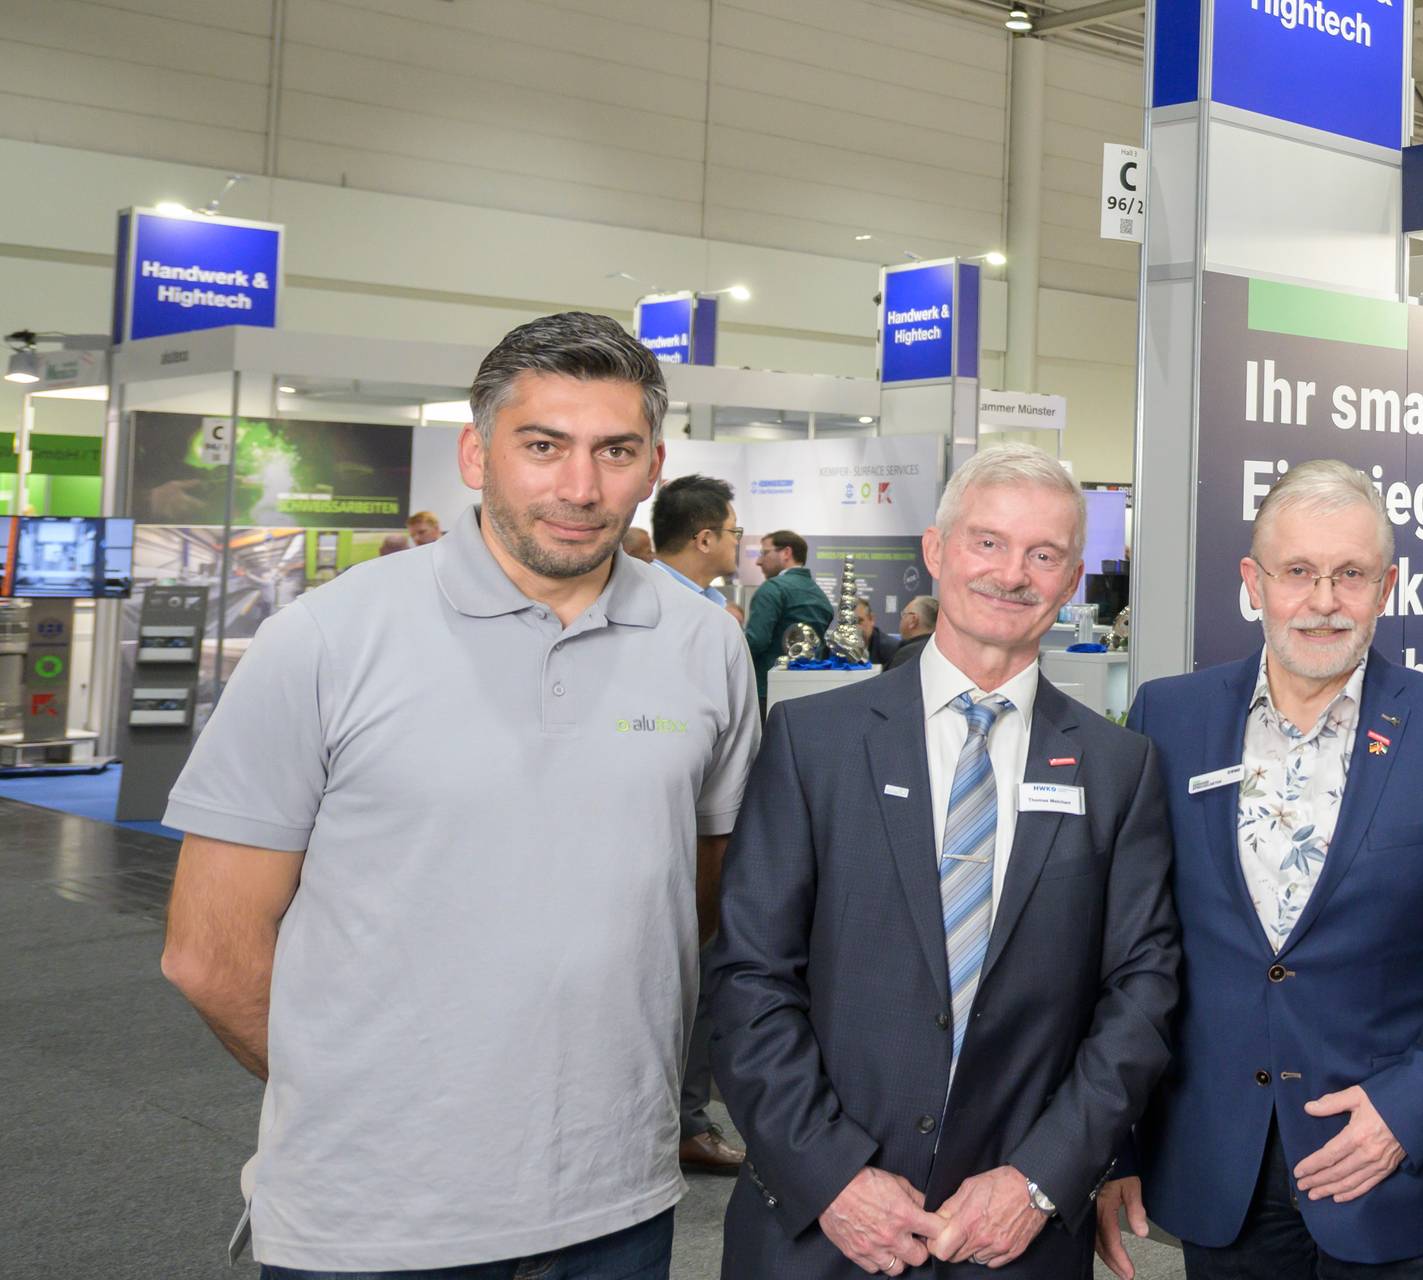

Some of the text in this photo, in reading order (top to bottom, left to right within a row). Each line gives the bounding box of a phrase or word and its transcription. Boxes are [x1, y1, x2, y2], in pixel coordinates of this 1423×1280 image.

[1120, 161, 1138, 191] C
[142, 260, 269, 289] Handwerk &
[157, 285, 252, 310] Hightech
[887, 304, 950, 325] Handwerk &
[895, 325, 942, 346] Hightech
[1246, 359, 1316, 426] Ihr
[980, 402, 1056, 417] ammer Münster
[212, 426, 224, 440] C
